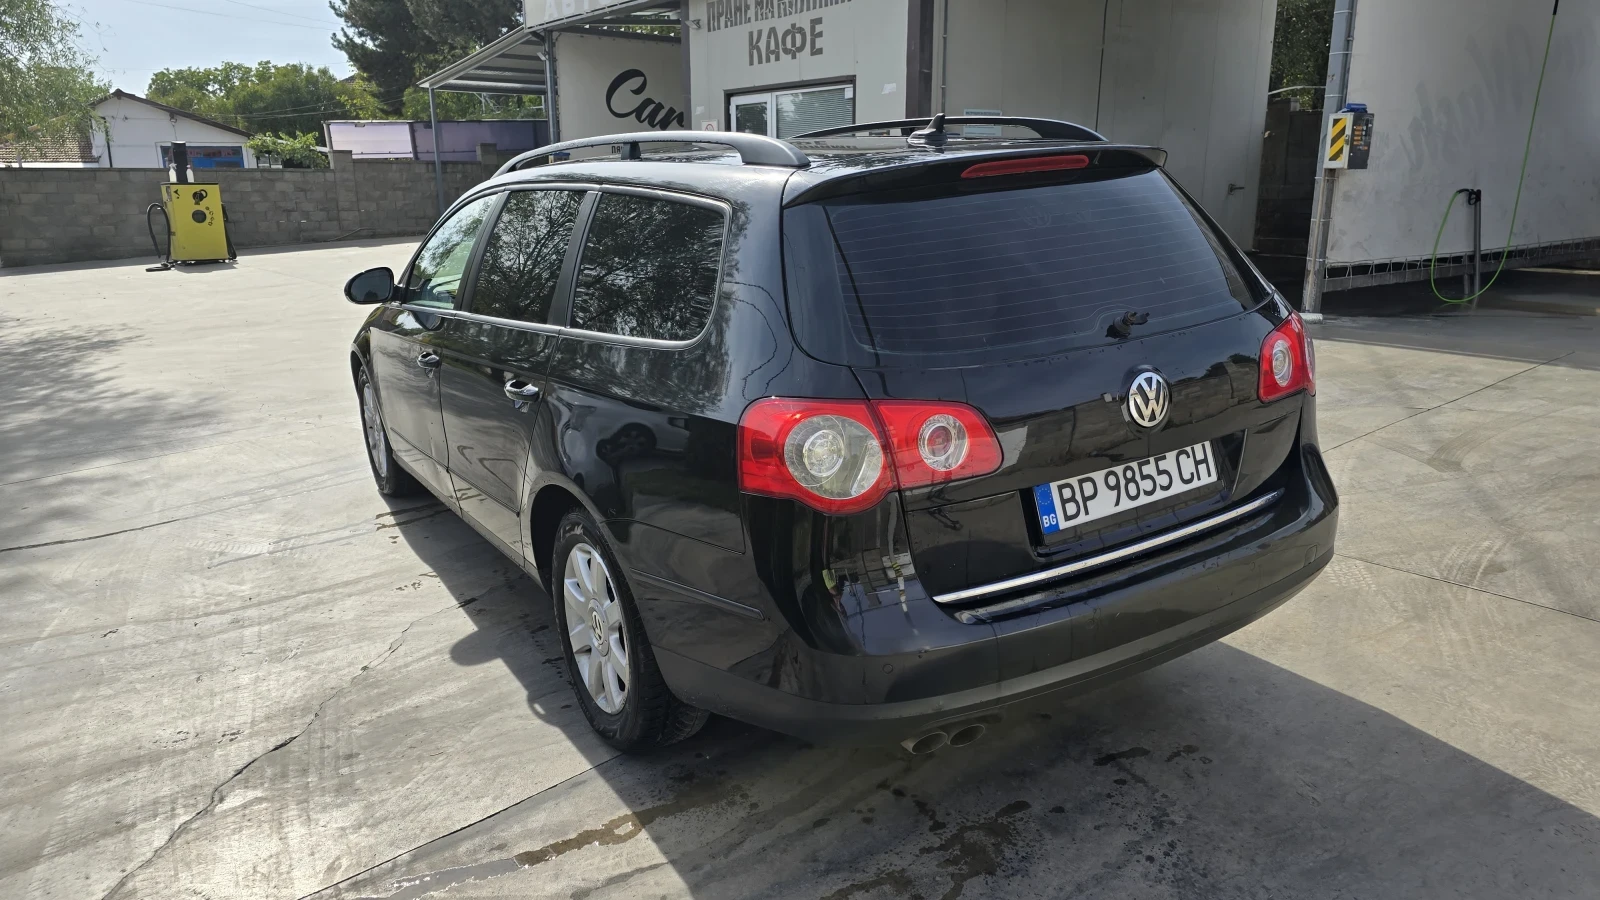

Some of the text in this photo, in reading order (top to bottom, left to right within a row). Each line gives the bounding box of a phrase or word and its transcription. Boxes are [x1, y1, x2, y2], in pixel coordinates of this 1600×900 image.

[748, 17, 823, 66] КАФЕ
[606, 69, 684, 131] Car
[1042, 443, 1212, 528] BG BP 9855 CH
